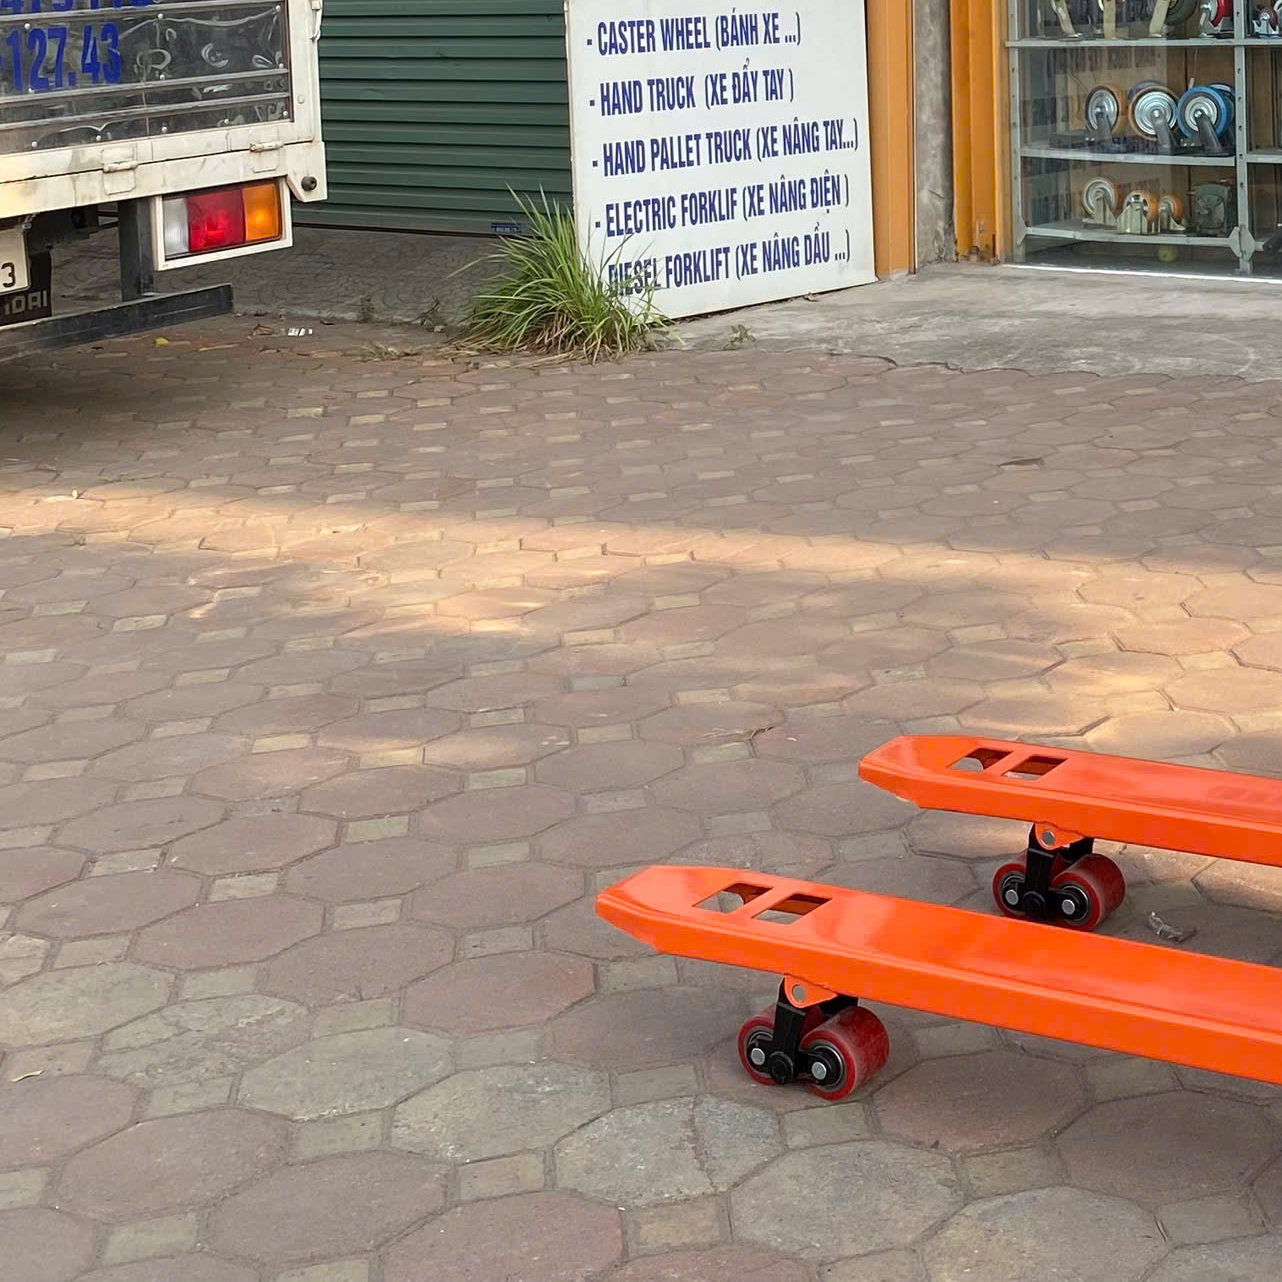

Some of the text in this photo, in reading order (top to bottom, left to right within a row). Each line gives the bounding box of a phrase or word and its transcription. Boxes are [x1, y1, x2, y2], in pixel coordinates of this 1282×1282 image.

[597, 19, 656, 56] CASTER
[660, 16, 711, 51] WHEEL
[715, 7, 759, 51] (BÁNH
[762, 12, 780, 45] XE
[600, 80, 643, 116] HAND
[647, 75, 696, 112] TRUCK
[704, 72, 728, 110] (XE
[732, 57, 759, 104] ĐẨY
[762, 68, 785, 101] TAY
[603, 139, 645, 177] HAND
[650, 133, 702, 171] PALLET
[705, 128, 752, 164] TRUCK
[756, 125, 778, 162] (XE
[782, 116, 820, 155] NÂNG
[605, 195, 677, 237] ELECTRIC
[680, 187, 737, 227] FORKLIF
[742, 183, 765, 221] (XE
[769, 174, 806, 214] NÂNG
[810, 169, 841, 214] ĐIỆN
[665, 246, 731, 288] FORKLIFT
[735, 242, 758, 280] (XE
[761, 232, 800, 272] NÂNG
[804, 221, 830, 266] DẦU
